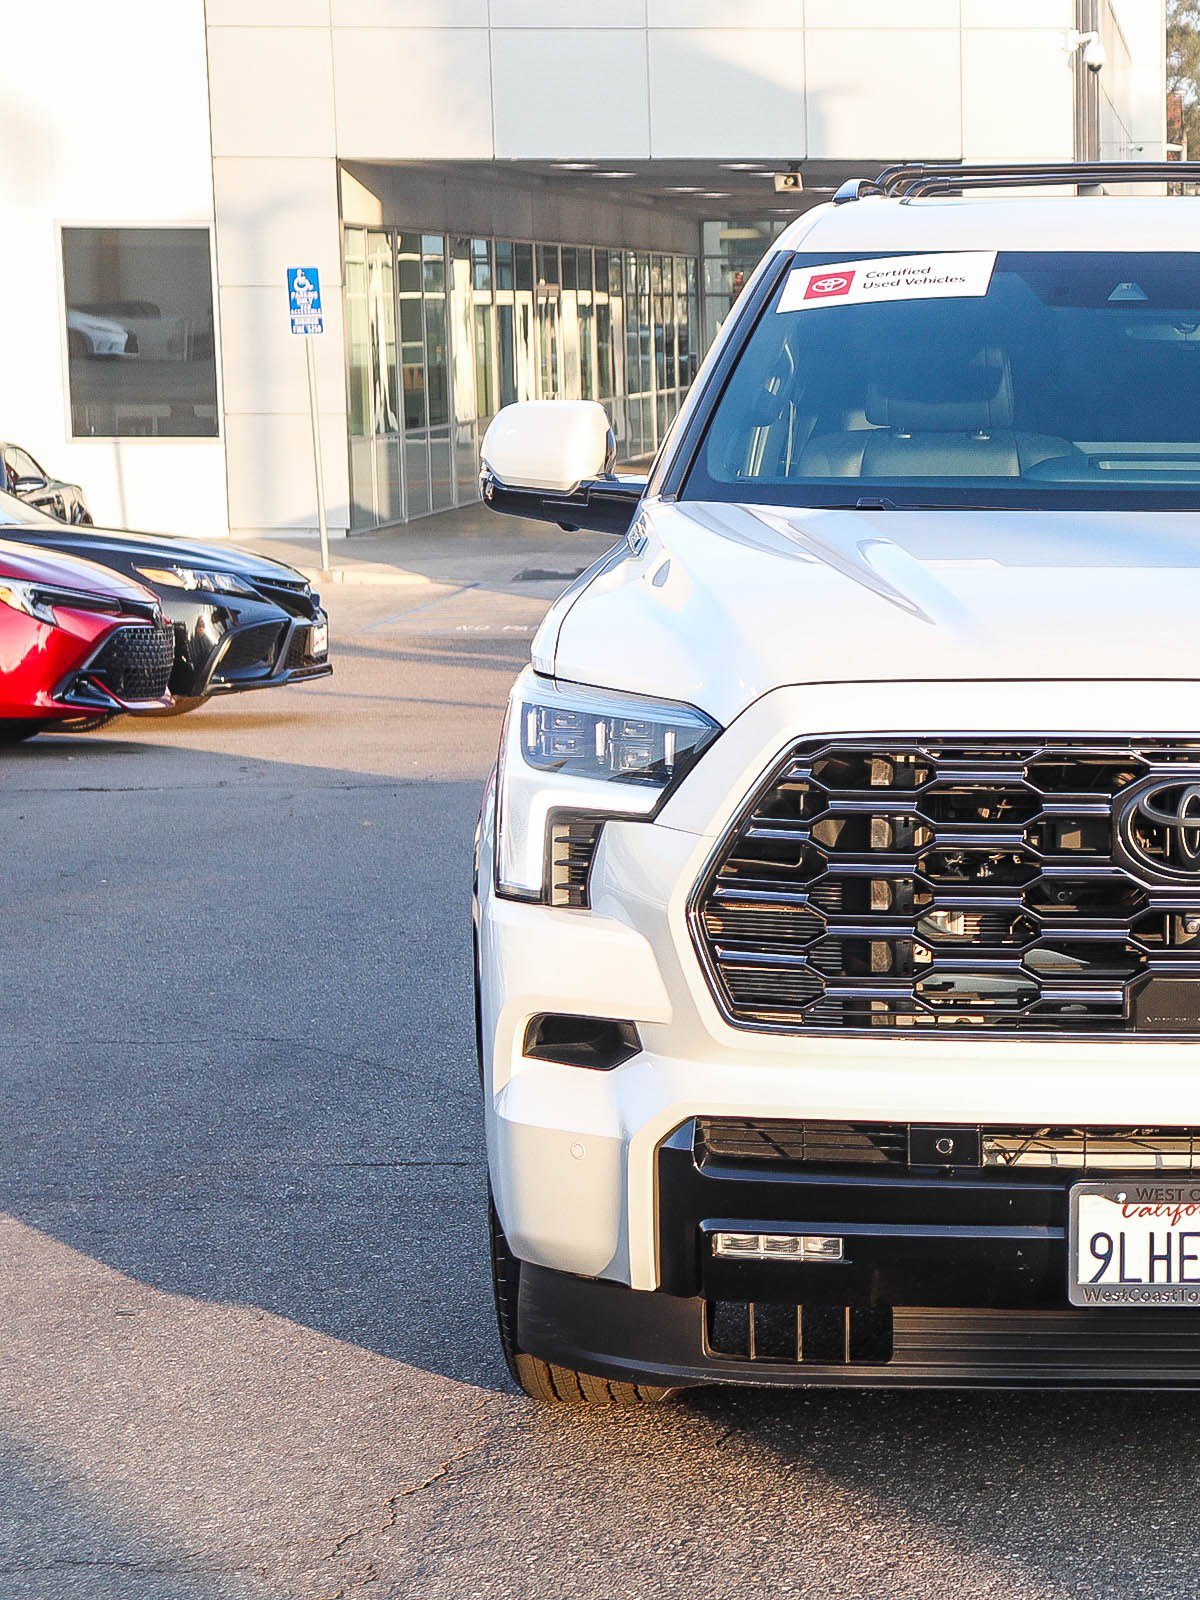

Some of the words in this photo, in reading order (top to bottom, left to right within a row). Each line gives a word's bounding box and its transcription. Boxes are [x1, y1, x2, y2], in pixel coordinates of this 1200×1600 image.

[865, 266, 932, 279] Certified
[863, 279, 901, 289] Used
[905, 275, 967, 286] Vehicles
[1136, 1187, 1185, 1202] WEST
